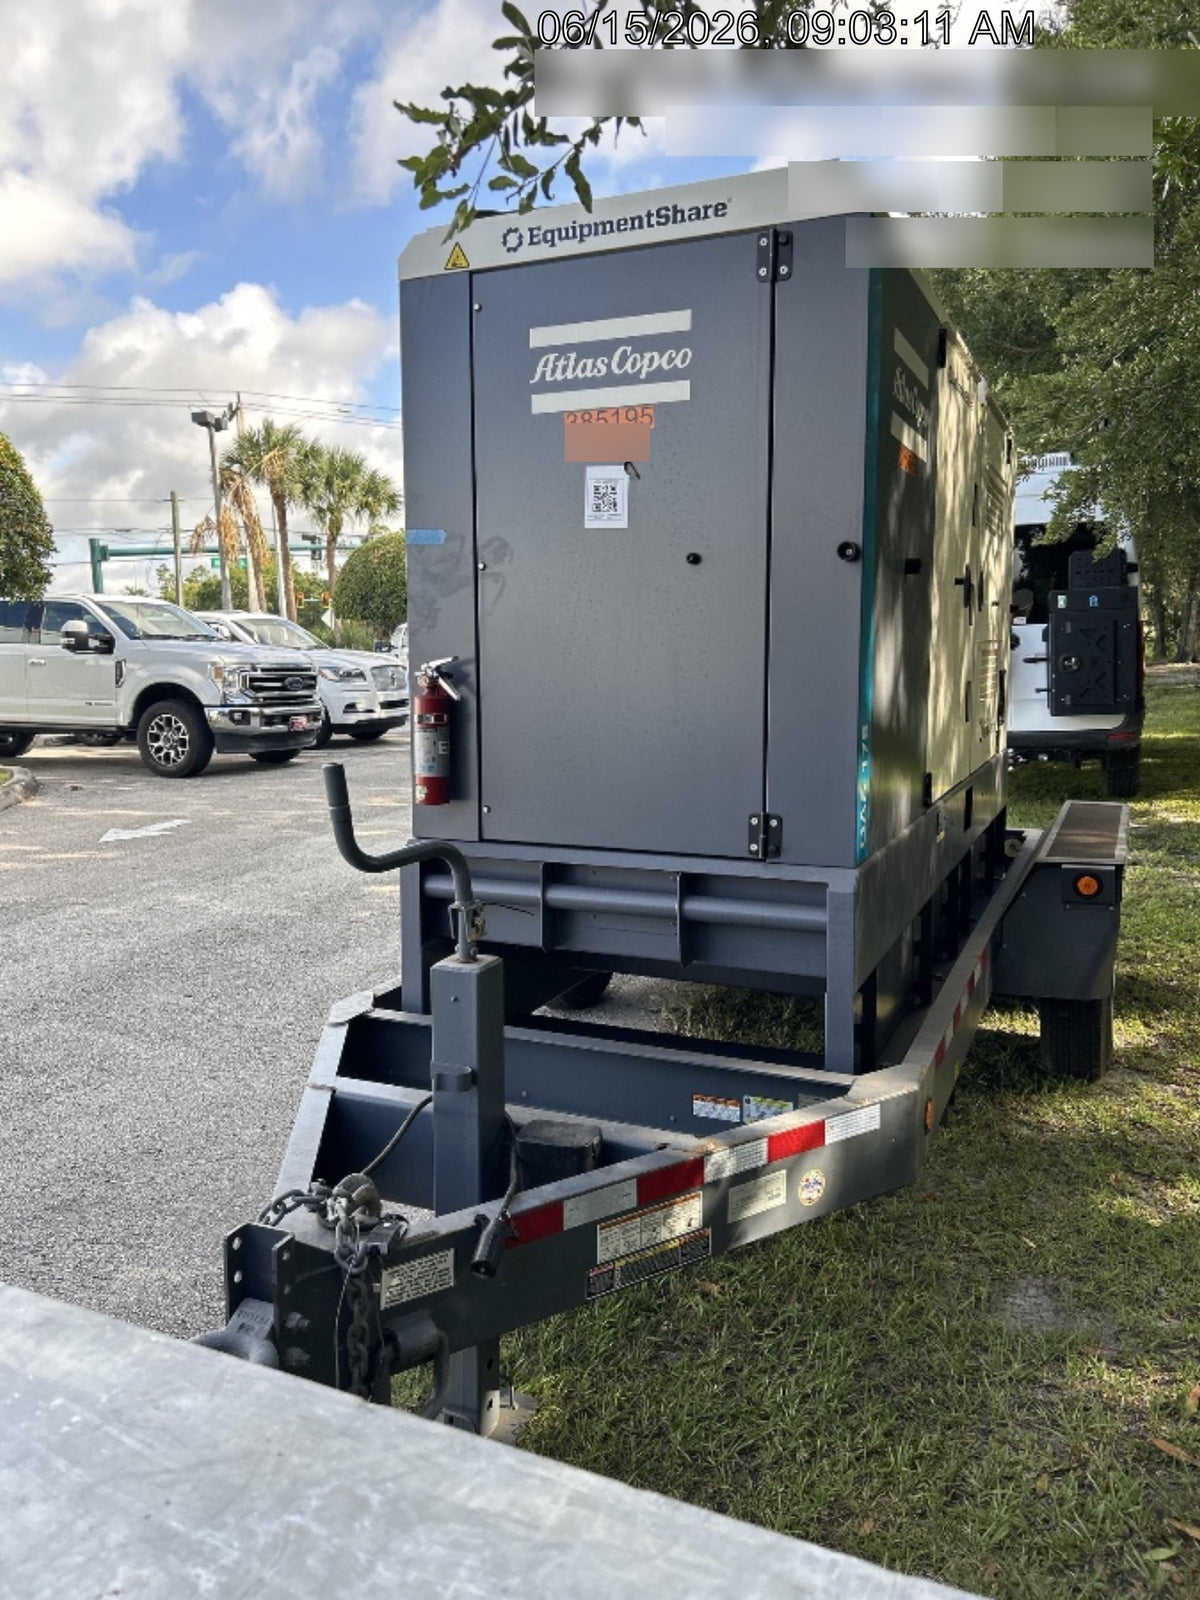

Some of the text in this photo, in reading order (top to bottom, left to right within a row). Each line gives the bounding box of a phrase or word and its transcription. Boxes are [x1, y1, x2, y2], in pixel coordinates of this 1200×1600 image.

[527, 201, 729, 247] EquipmentShare
[529, 345, 692, 384] Atlas Copco
